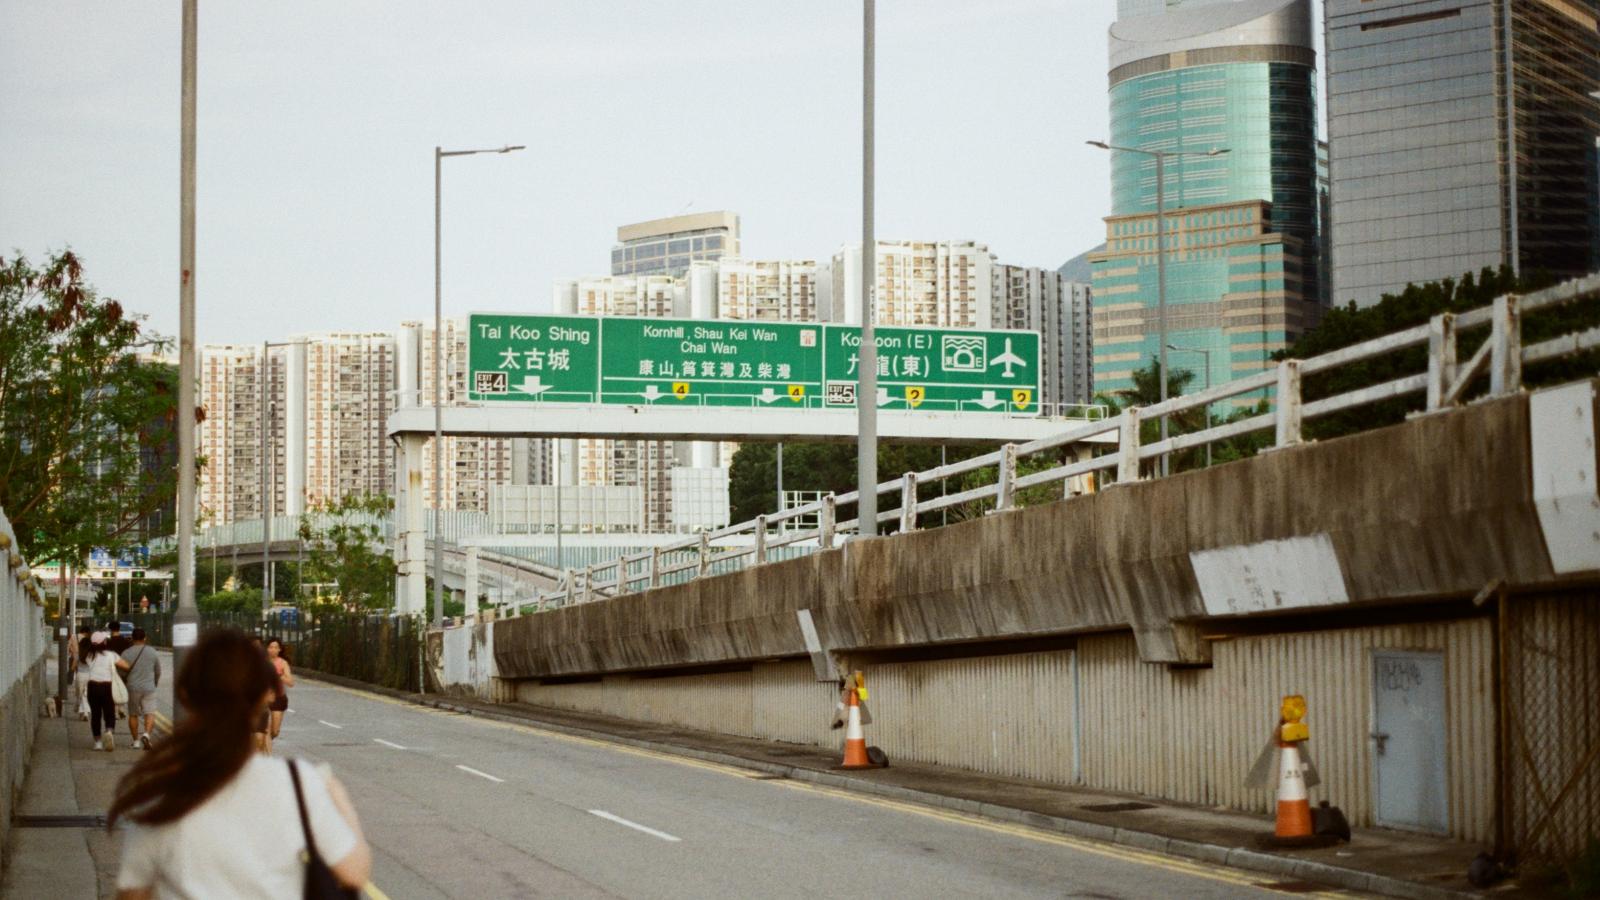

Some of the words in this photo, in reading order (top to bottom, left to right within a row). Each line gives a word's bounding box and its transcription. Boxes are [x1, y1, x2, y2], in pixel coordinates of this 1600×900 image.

[478, 324, 501, 339] Tai
[510, 325, 541, 340] Koo
[548, 326, 590, 345] Shing
[694, 327, 723, 339] Shau
[729, 328, 747, 340] Kei
[752, 330, 778, 341] Wan
[841, 332, 902, 348] Kooon
[907, 333, 933, 349] (E)
[680, 341, 706, 353] Chai
[711, 342, 737, 354] Wan
[499, 347, 570, 370] 太古城
[975, 356, 983, 368] E
[493, 374, 505, 392] 4
[676, 385, 685, 394] 4
[792, 388, 800, 397] 4
[843, 386, 854, 402] 5
[911, 389, 920, 400] 2
[1017, 392, 1026, 402] 2
